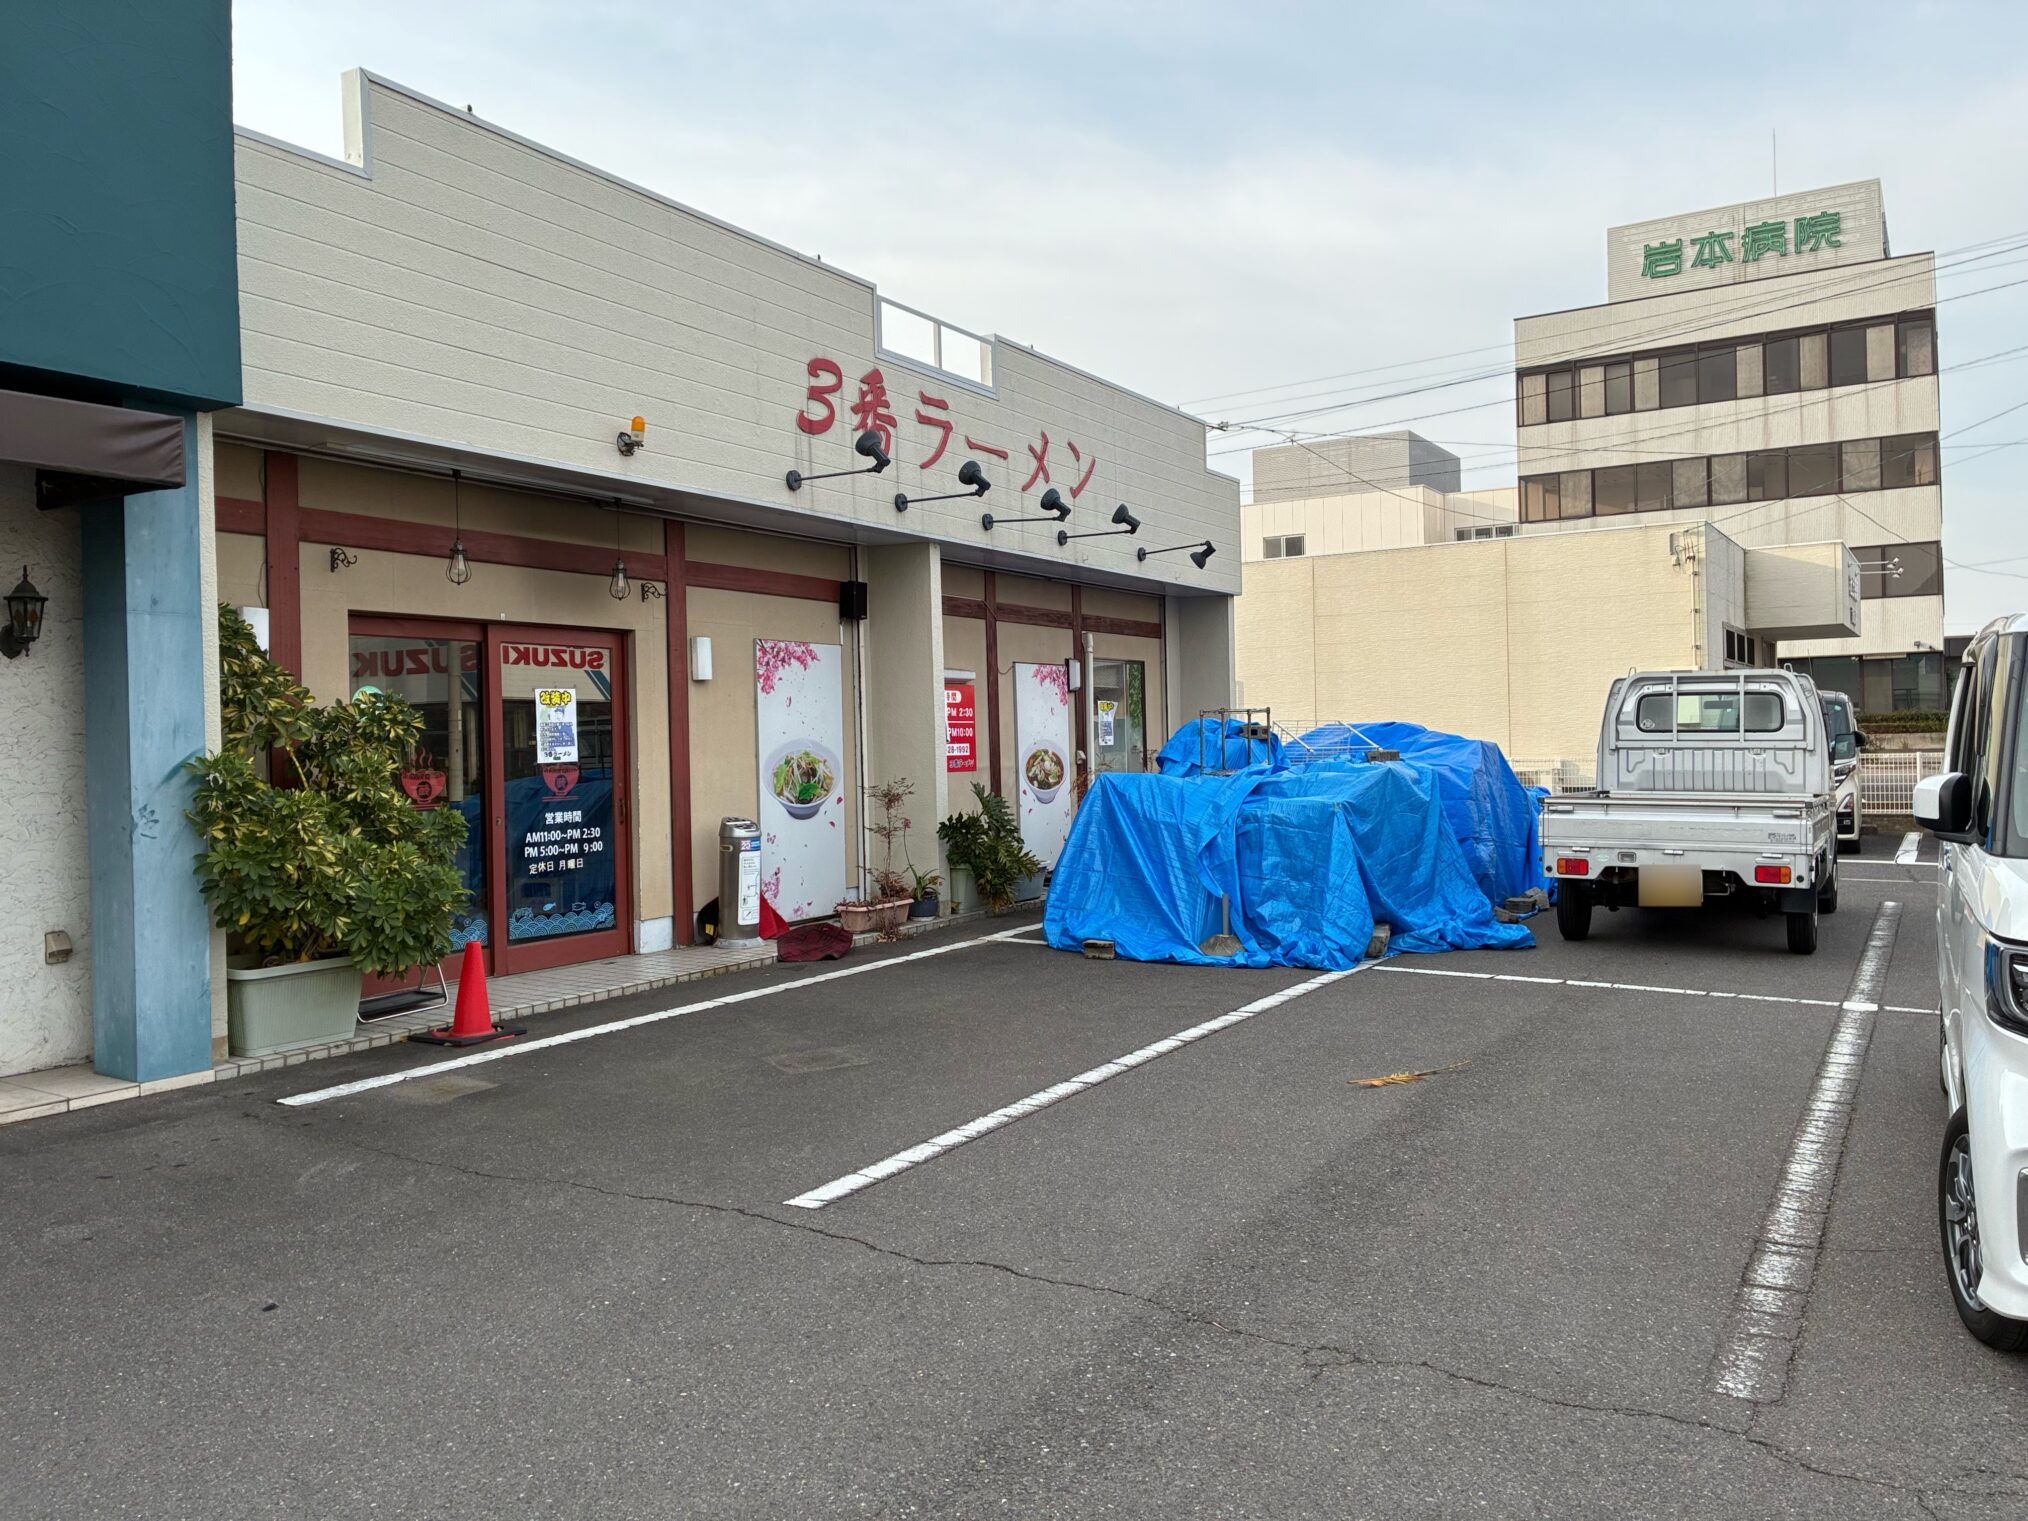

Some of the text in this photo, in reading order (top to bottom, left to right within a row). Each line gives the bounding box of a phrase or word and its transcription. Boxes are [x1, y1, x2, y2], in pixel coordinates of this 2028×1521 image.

[1642, 211, 1841, 279] 岩本病院
[796, 357, 1096, 499] 3番ラーメン
[959, 707, 973, 717] 2:30
[544, 810, 582, 825] 営業時間
[582, 827, 601, 839] 2:30
[524, 846, 539, 858] PM
[528, 858, 584, 875] 定休日 月曜日
